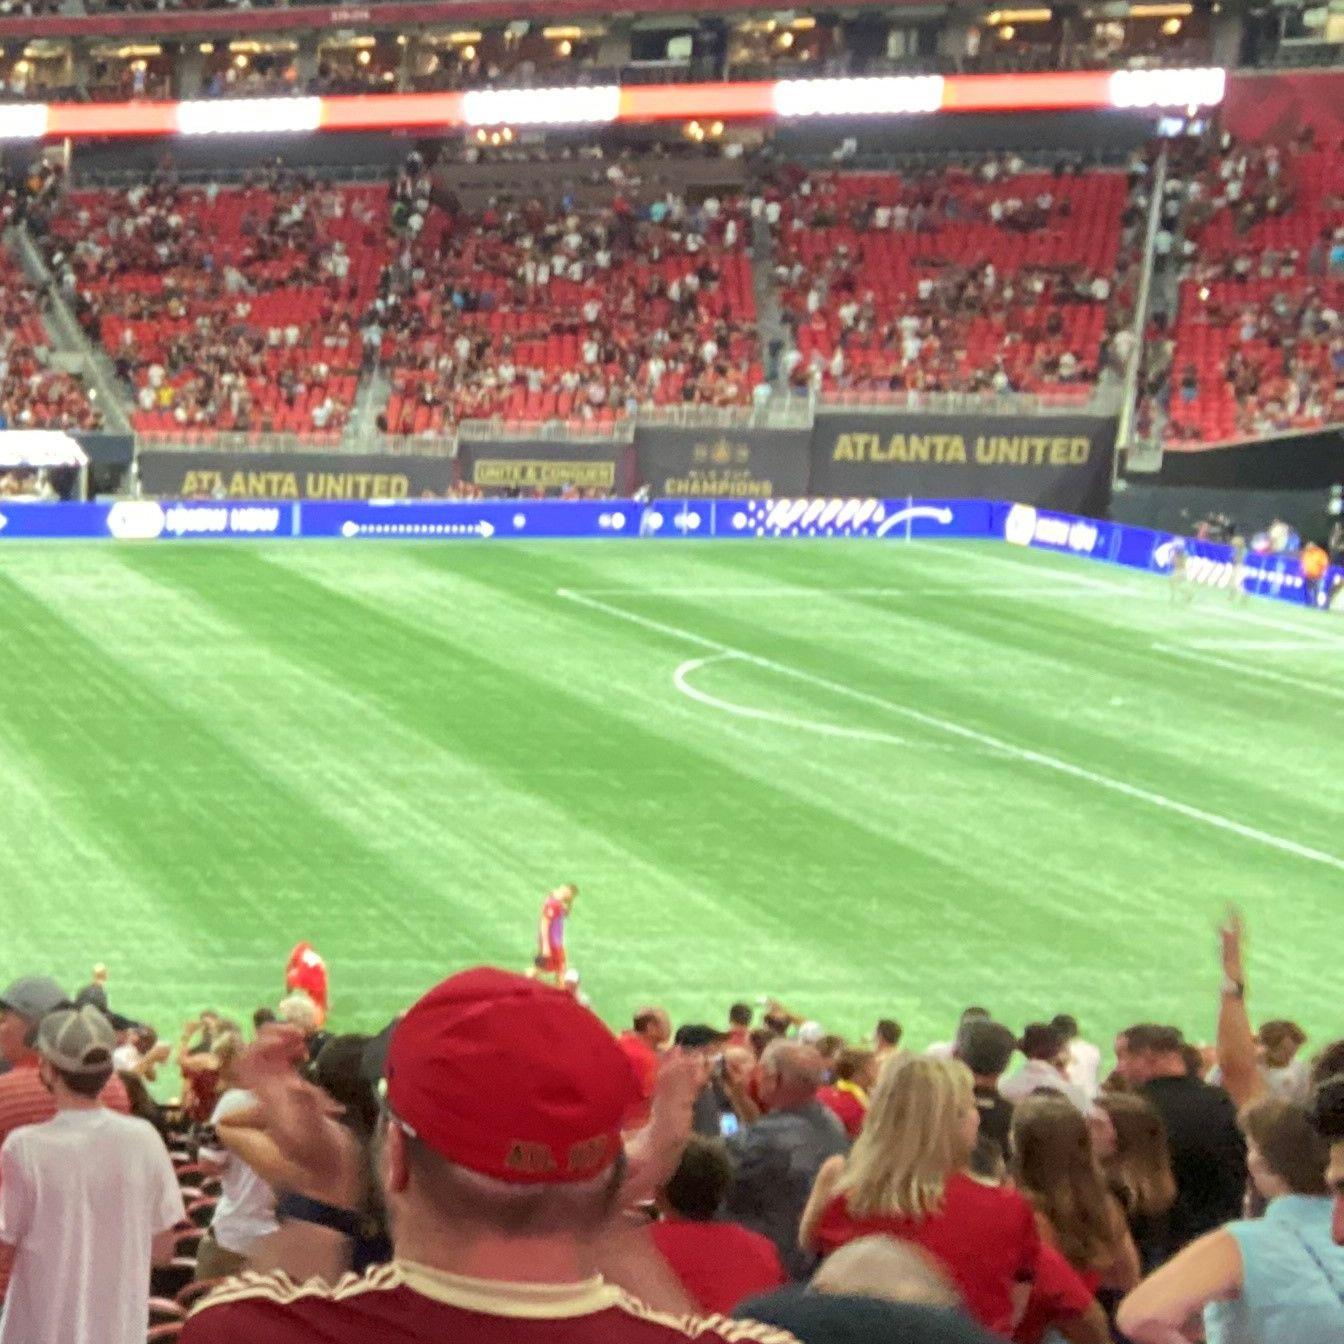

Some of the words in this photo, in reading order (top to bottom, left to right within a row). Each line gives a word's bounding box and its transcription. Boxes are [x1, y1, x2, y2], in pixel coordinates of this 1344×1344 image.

[832, 432, 967, 464] ATLANTA
[975, 436, 1091, 465] UNITED
[306, 472, 410, 499] UNITED
